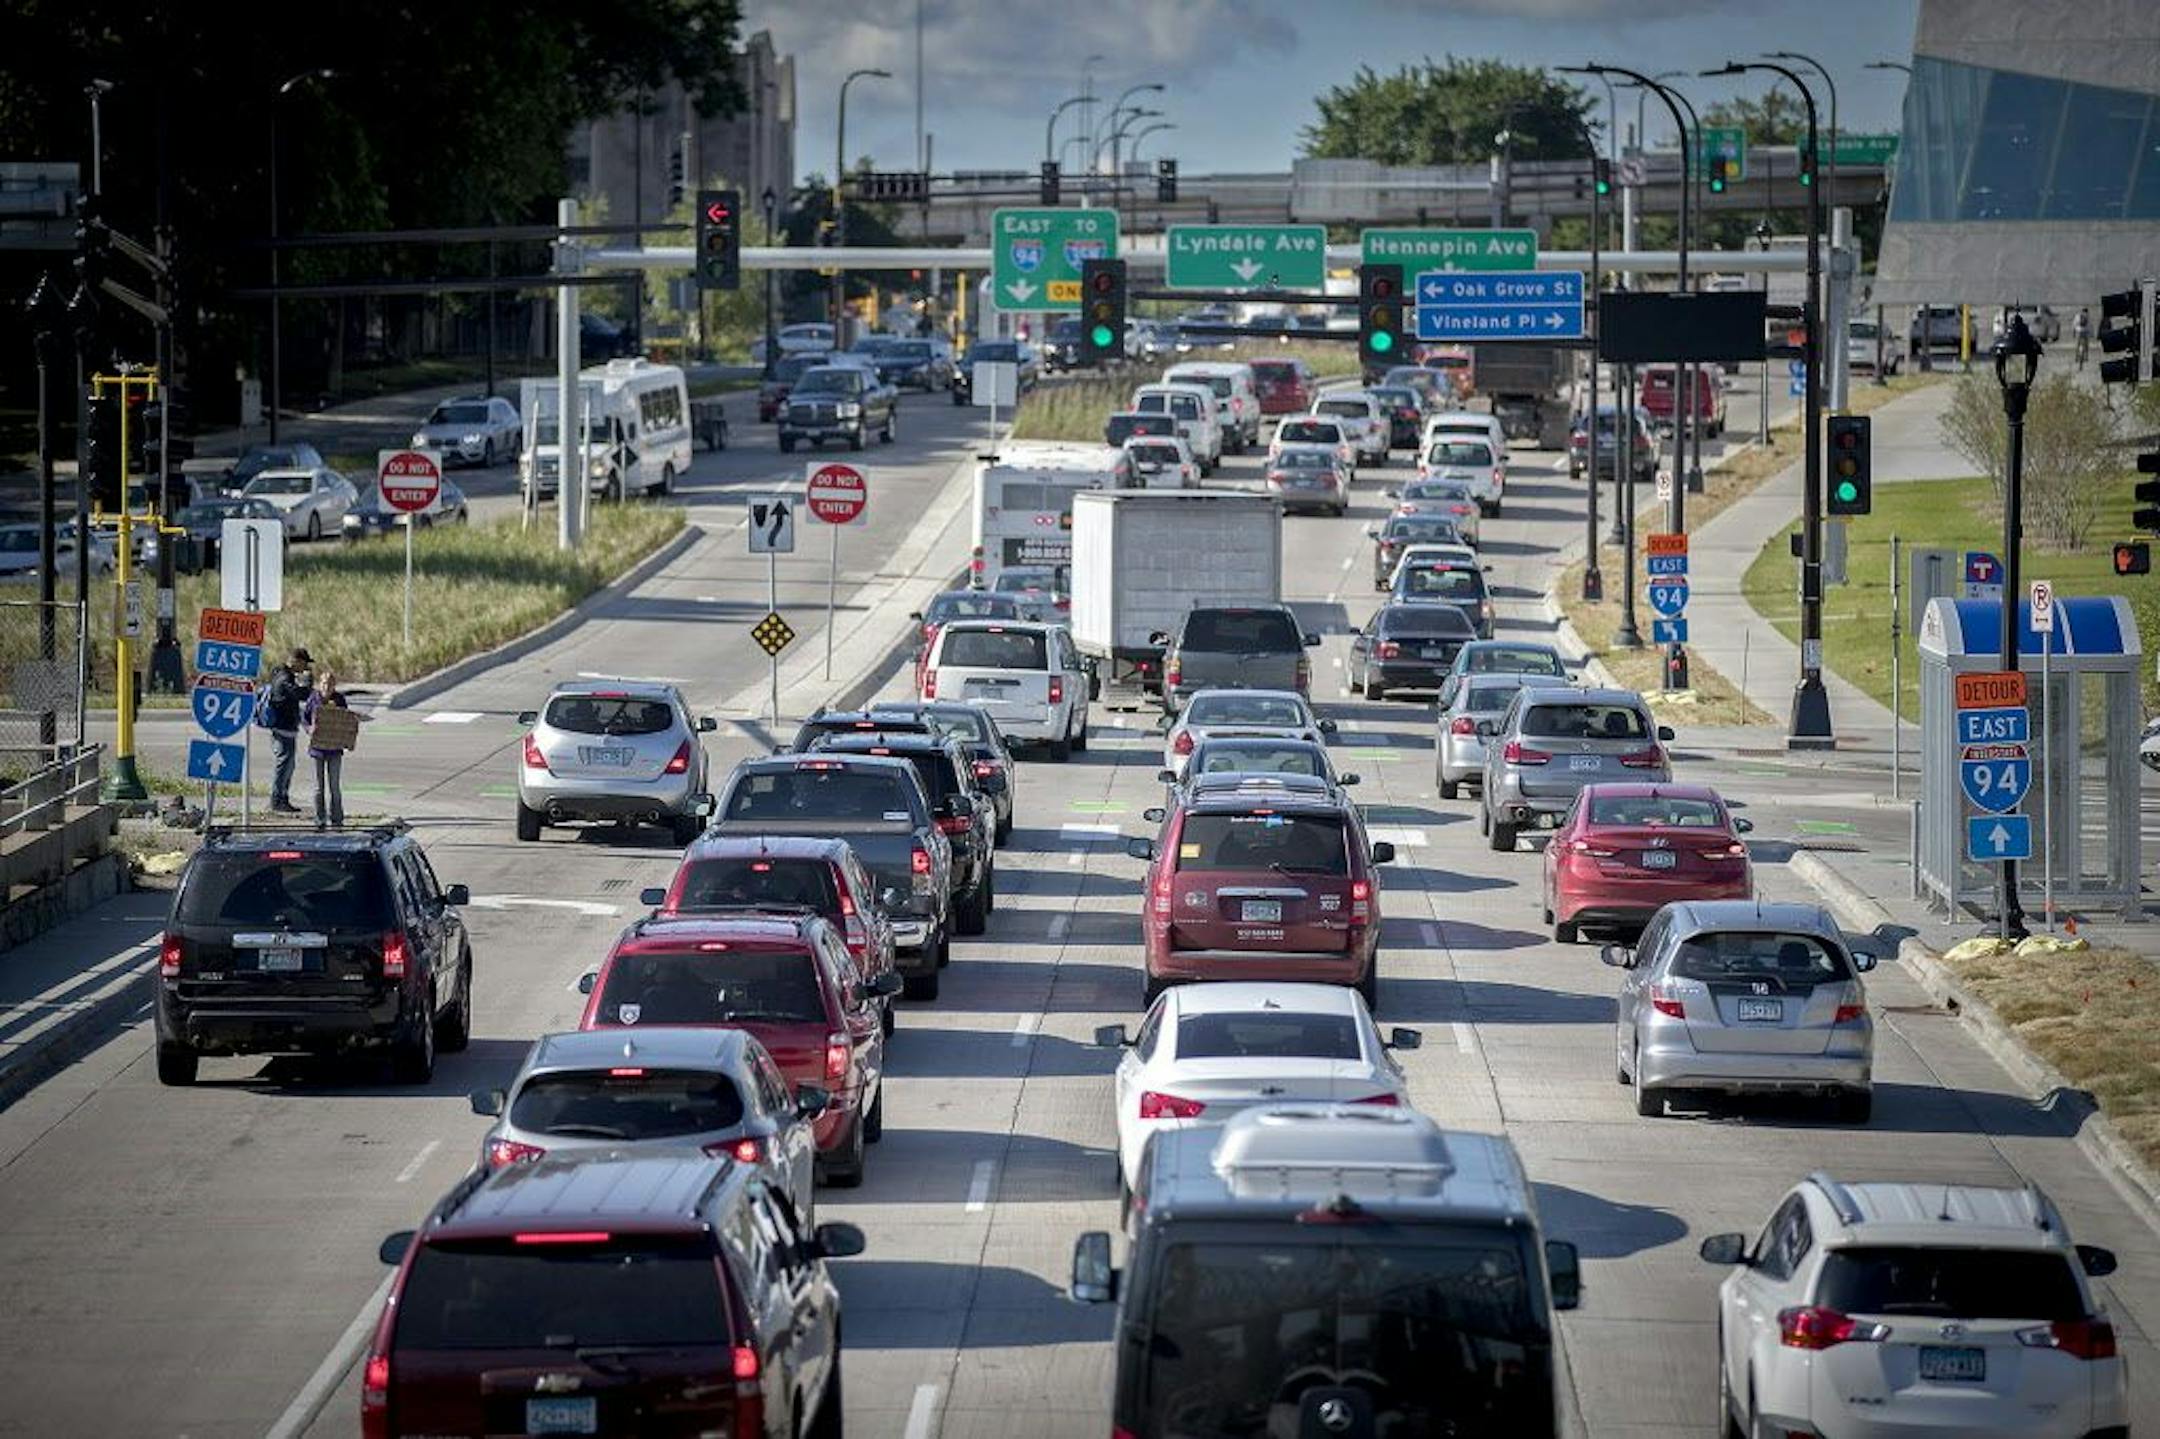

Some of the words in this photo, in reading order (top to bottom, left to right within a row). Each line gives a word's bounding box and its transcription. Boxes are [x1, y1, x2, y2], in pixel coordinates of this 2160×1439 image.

[1004, 217, 1050, 233] EAST
[1075, 218, 1098, 232] TO
[1176, 233, 1266, 254] Lyndale
[1275, 233, 1317, 251] Ave
[1370, 237, 1477, 257] Hennepin
[1486, 238, 1528, 255] Ave
[1015, 250, 1039, 264] 94
[1453, 282, 1486, 297] Oak
[1495, 282, 1545, 297] Grove
[1553, 281, 1574, 296] St
[1431, 314, 1511, 330] Vineland
[389, 462, 405, 474] DO
[409, 462, 432, 475] NOT
[816, 475, 832, 486] DO
[836, 475, 858, 487] NOT
[391, 490, 428, 502] ENTER
[1653, 559, 1683, 573] EAST
[1656, 587, 1683, 608] 94
[206, 616, 259, 638] DETOUR
[205, 647, 252, 670] EAST
[1963, 680, 2020, 701] DETOUR
[203, 693, 242, 726] 94
[1968, 716, 2018, 739] EAST
[1973, 763, 2018, 797] 94
